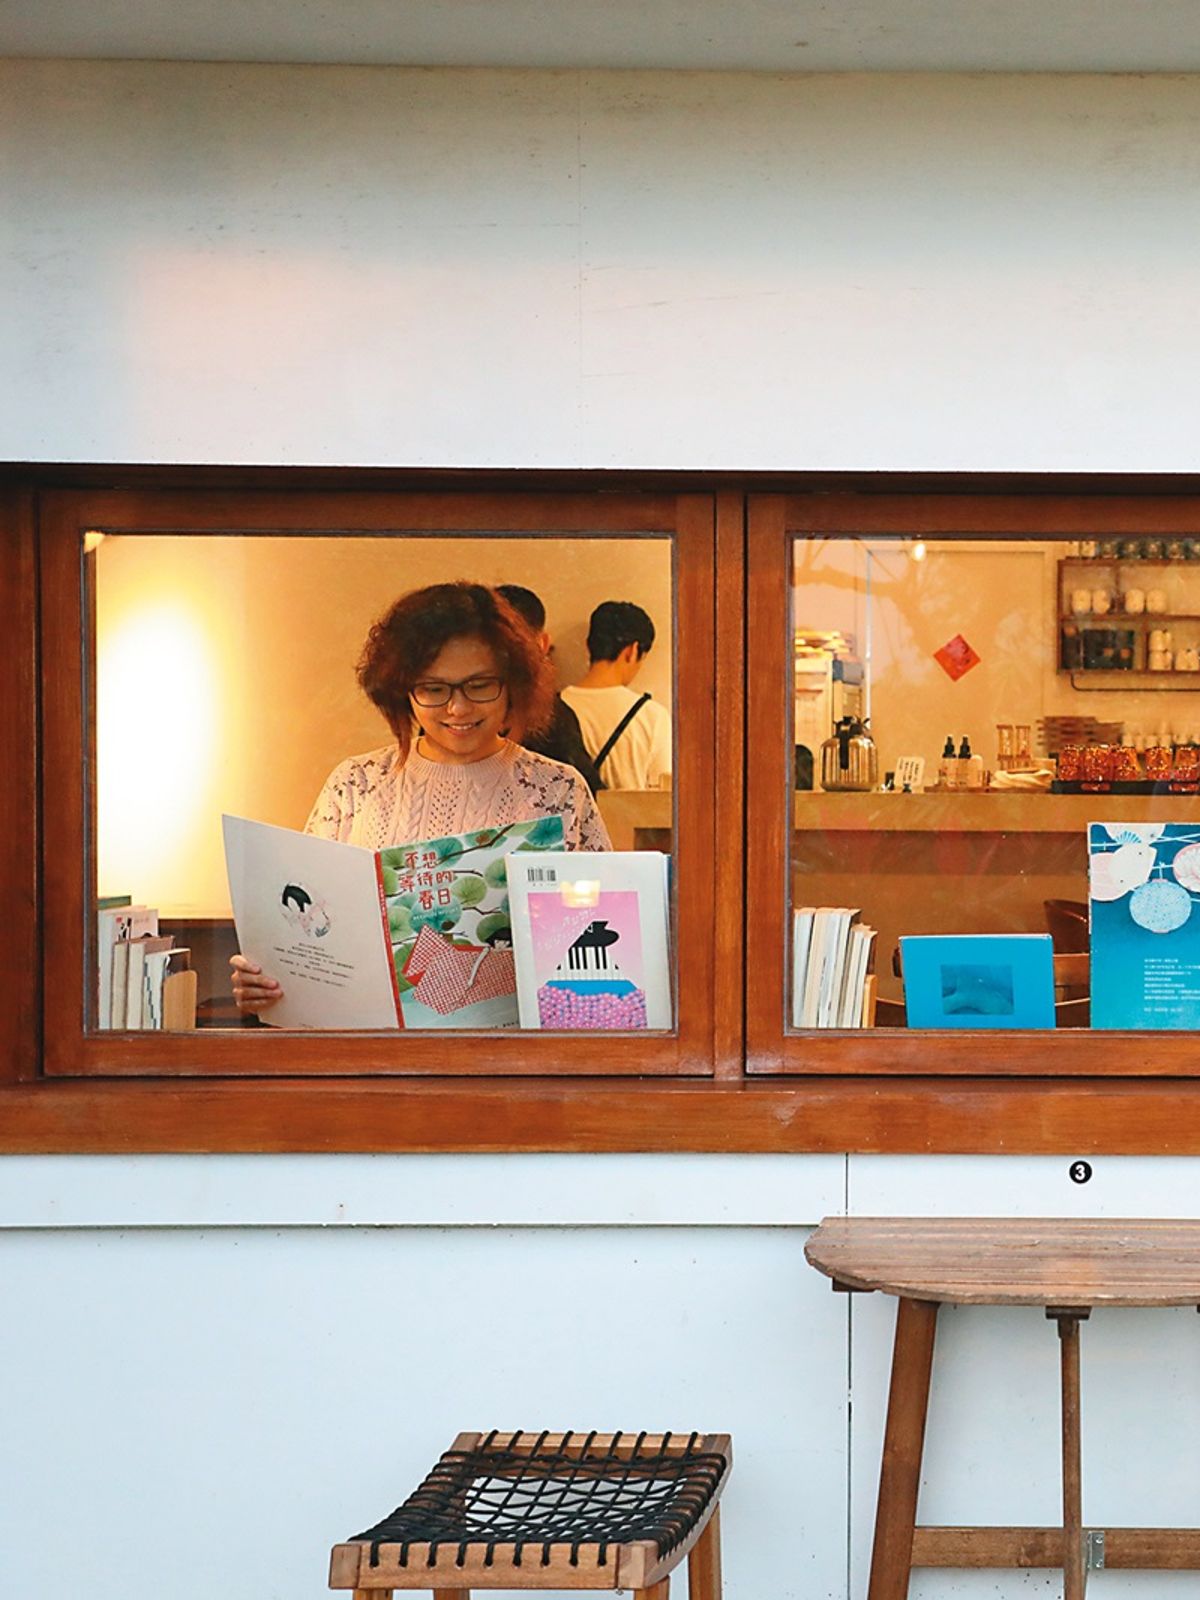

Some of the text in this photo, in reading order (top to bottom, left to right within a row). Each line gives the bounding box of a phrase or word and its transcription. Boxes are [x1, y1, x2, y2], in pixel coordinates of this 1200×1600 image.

[404, 851, 437, 870] 不想
[399, 870, 454, 893] 等待的
[418, 887, 451, 911] 春日
